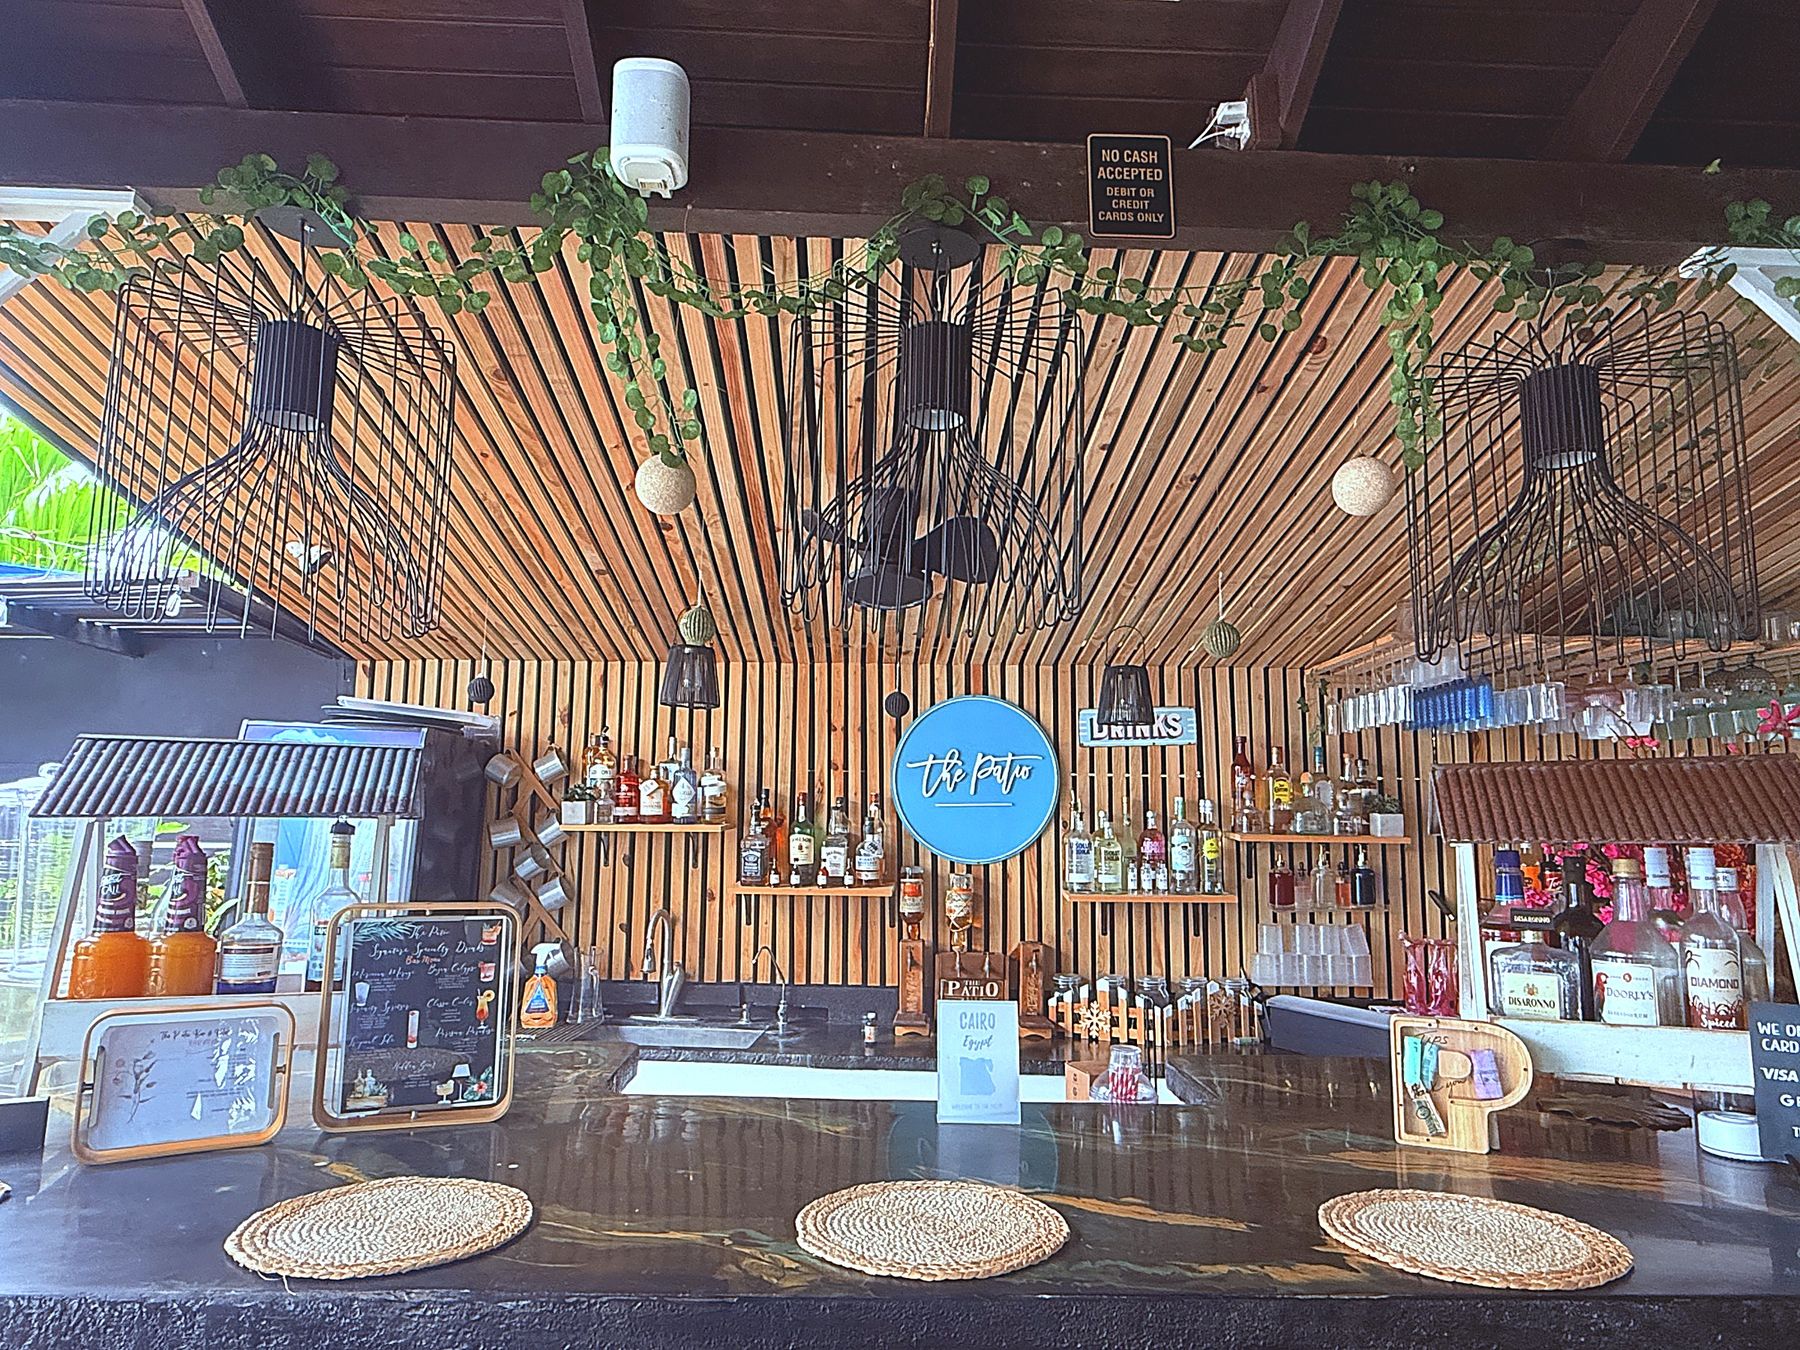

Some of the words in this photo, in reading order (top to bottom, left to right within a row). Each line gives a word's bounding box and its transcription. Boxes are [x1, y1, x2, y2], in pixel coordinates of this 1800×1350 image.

[1101, 149, 1120, 163] NO
[1123, 150, 1158, 164] CASH
[1097, 166, 1163, 181] ACCEPTED
[1106, 186, 1137, 197] DEBIT
[1139, 187, 1155, 198] OR
[1111, 199, 1150, 210] CREDIT
[1098, 211, 1134, 221] CARDS
[1137, 212, 1164, 223] ONLY
[906, 748, 968, 798] the
[1513, 915, 1551, 924] DISARONNO
[948, 980, 999, 998] PATIO
[1690, 976, 1739, 989] DIAMOND
[1606, 987, 1654, 1001] DOORLY'S
[1508, 996, 1556, 1009] DISARONNO
[959, 1011, 996, 1031] CAIRO
[1757, 1022, 1780, 1036] WE
[962, 1034, 993, 1051] Egypt
[1760, 1066, 1799, 1083] VISA
